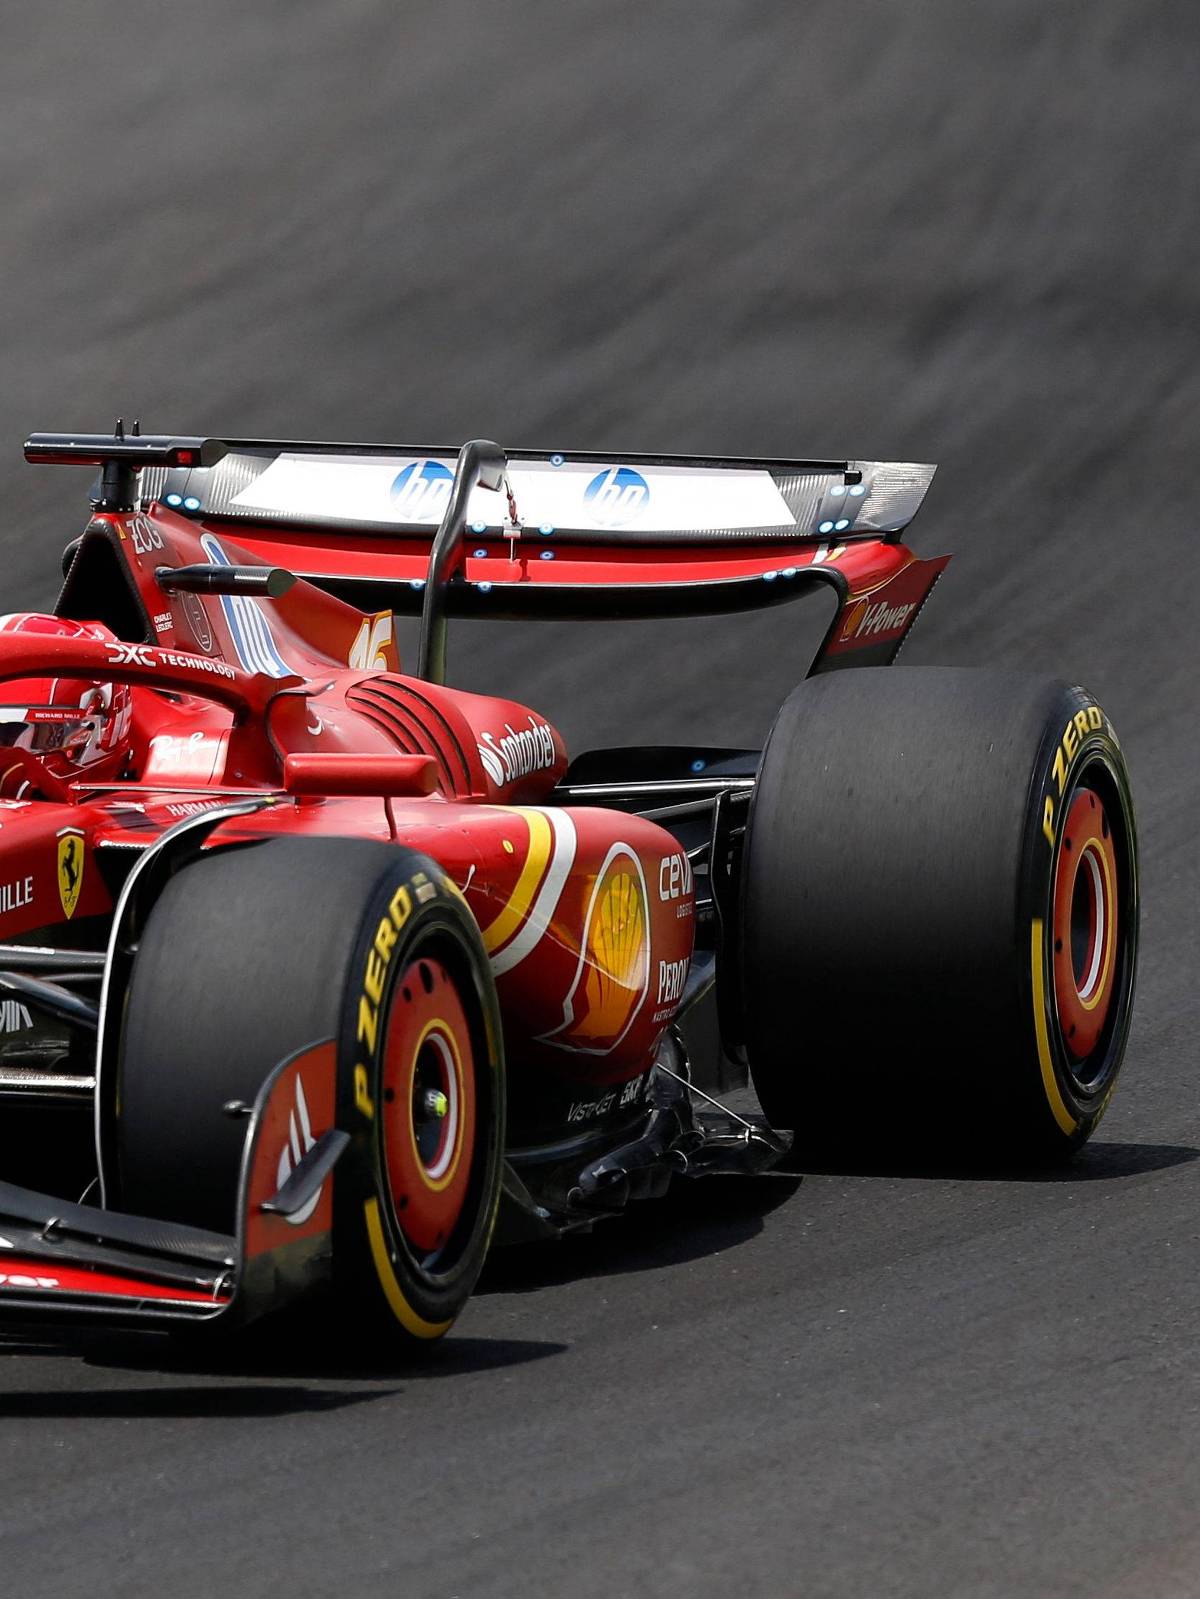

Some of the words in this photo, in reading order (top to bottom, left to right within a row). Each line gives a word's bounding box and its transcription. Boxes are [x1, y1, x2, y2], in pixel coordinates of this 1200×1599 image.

[593, 467, 648, 526] hp
[855, 601, 917, 638] V-Power
[105, 643, 157, 667] DXC
[159, 652, 236, 681] TECHNOLOGY
[481, 716, 556, 782] Santander
[1042, 796, 1056, 848] P
[1052, 706, 1102, 797] ZERO
[357, 884, 413, 1056] ZERO
[353, 1063, 375, 1121] P
